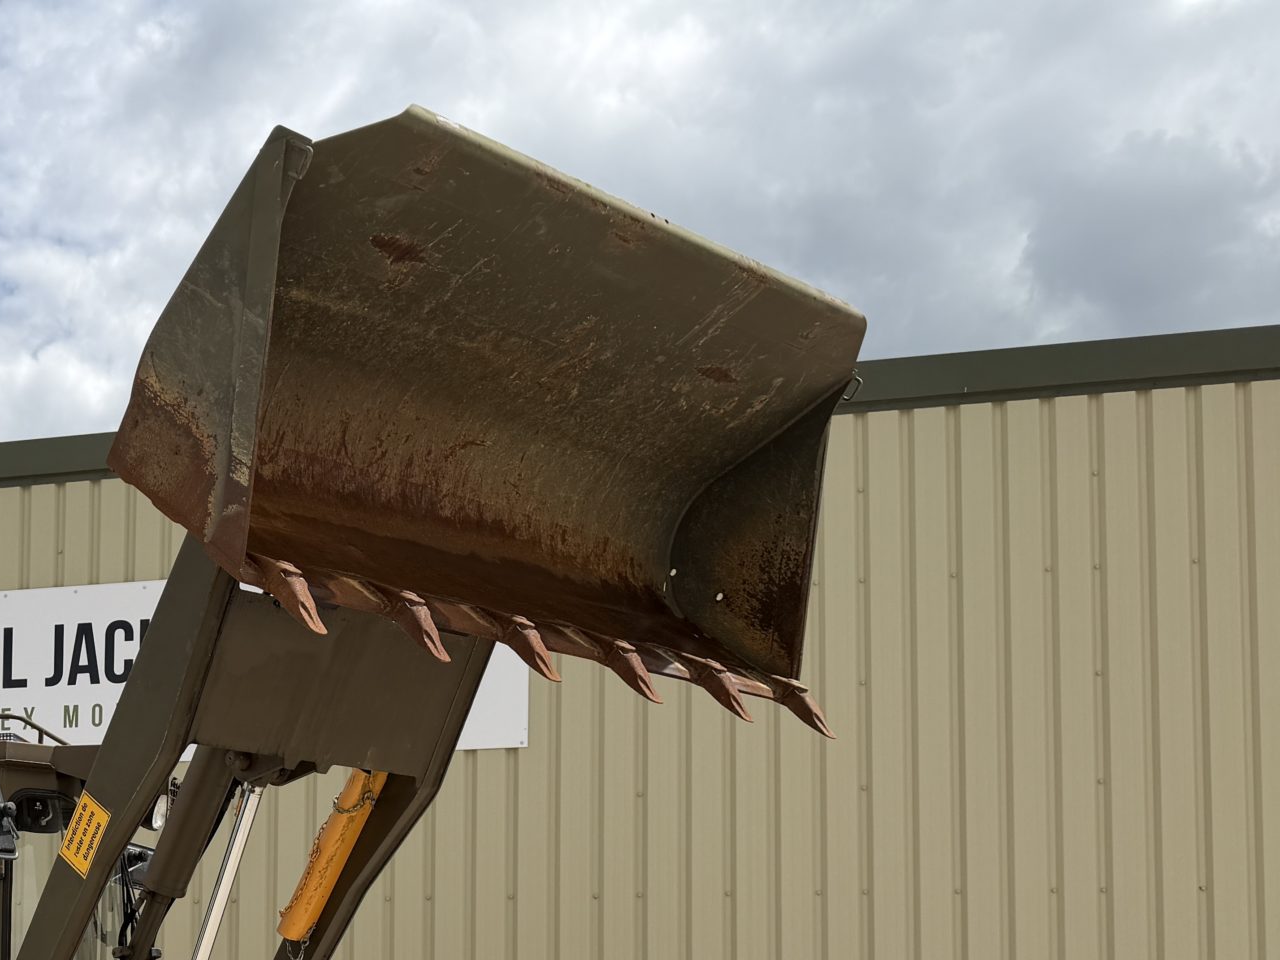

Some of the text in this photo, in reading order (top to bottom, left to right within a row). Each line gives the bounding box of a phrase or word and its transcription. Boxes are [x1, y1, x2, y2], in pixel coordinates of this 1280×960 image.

[2, 627, 28, 689] L
[1, 706, 36, 731] EX
[65, 812, 84, 851] Interdiction
[82, 821, 102, 861] dangereuse
